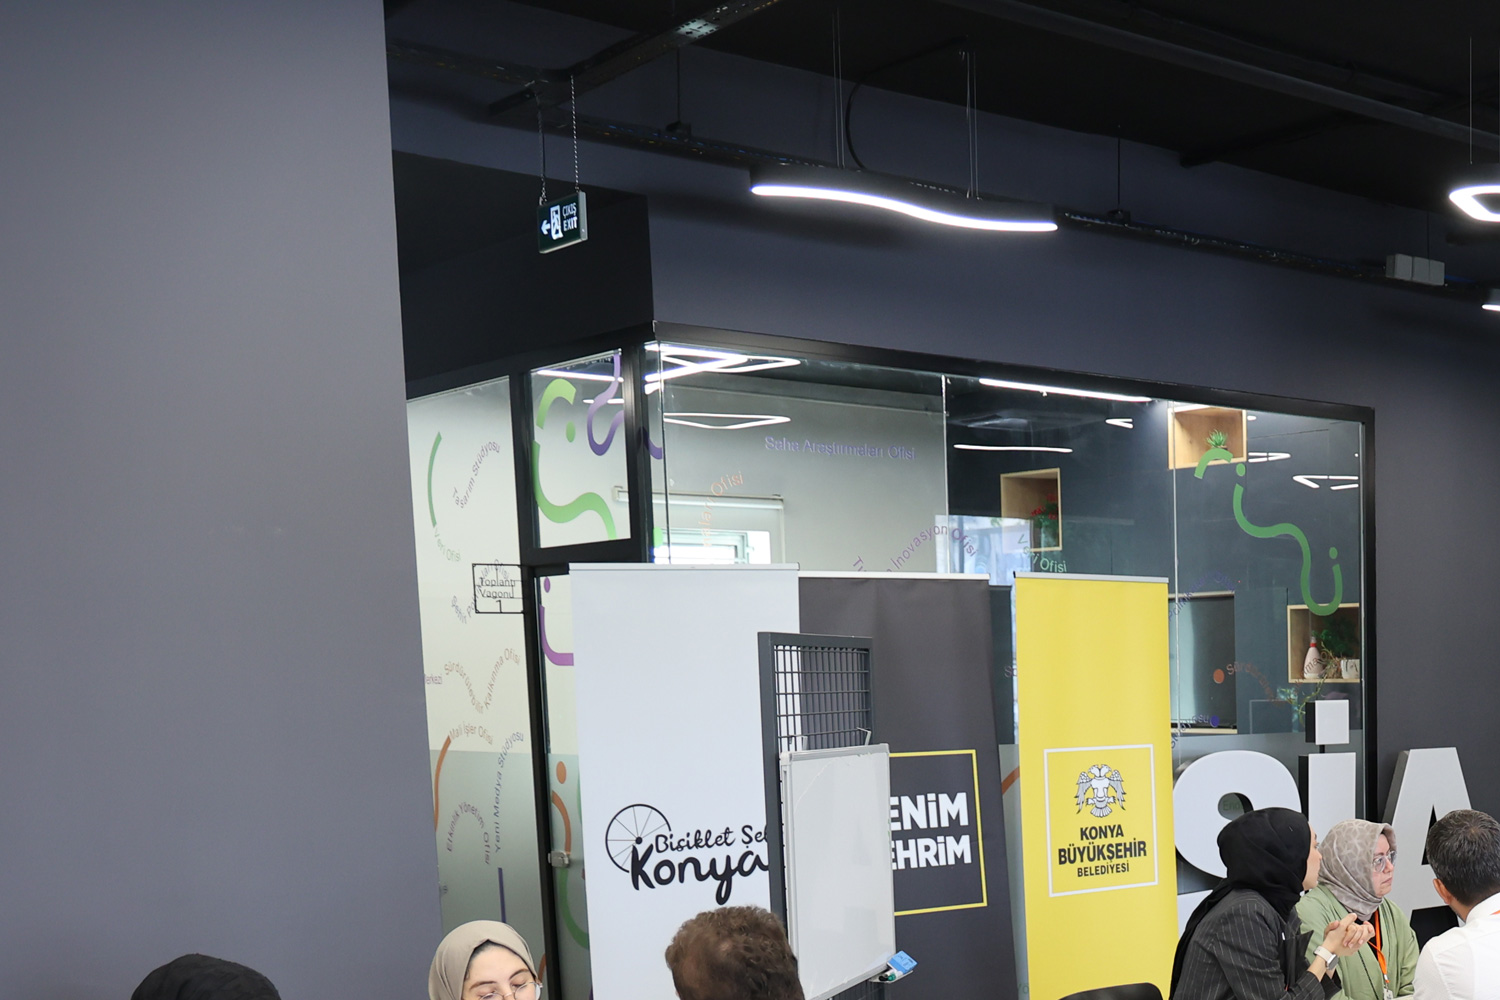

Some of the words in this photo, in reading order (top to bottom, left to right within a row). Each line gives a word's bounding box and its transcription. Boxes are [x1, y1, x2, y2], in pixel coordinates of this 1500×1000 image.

[563, 216, 578, 231] EXIT
[764, 436, 799, 451] Saha
[655, 827, 736, 853] Bisiklet
[1080, 824, 1124, 841] KONYA
[1058, 838, 1147, 865] BÜYÜKŞEHİR
[631, 844, 769, 905] Konya
[1077, 860, 1130, 877] BELEDİYESİ
